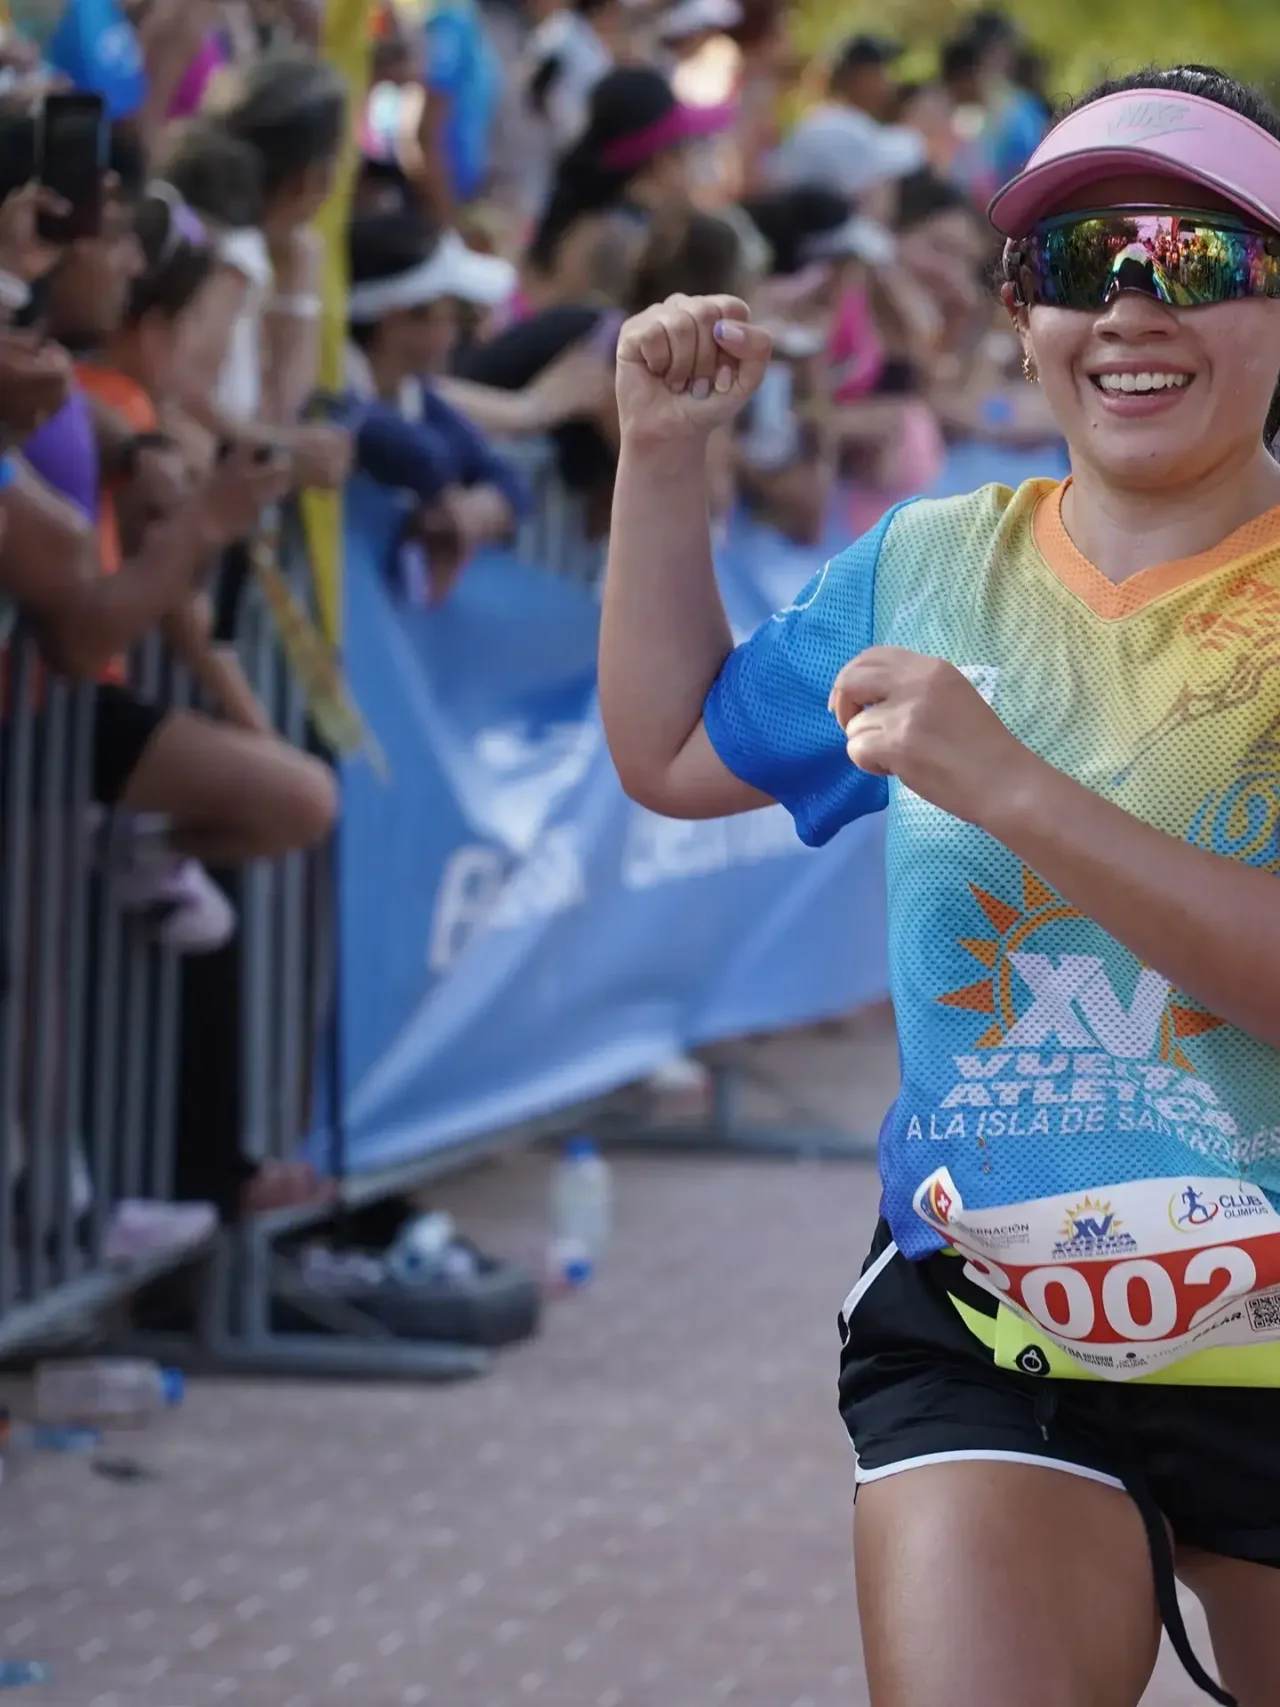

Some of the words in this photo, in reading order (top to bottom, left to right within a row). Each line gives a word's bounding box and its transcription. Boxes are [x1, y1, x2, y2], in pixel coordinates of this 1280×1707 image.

[1001, 951, 1172, 1060] XV
[952, 1053, 1219, 1106] VUELTA
[906, 1115, 922, 1141] A
[930, 1112, 966, 1140] LA
[976, 1107, 1049, 1138] ISLA
[1060, 1105, 1107, 1133] DE
[1219, 1194, 1263, 1208] CLUB
[1223, 1206, 1269, 1219] OLIMPUS
[1072, 1213, 1115, 1239] XV
